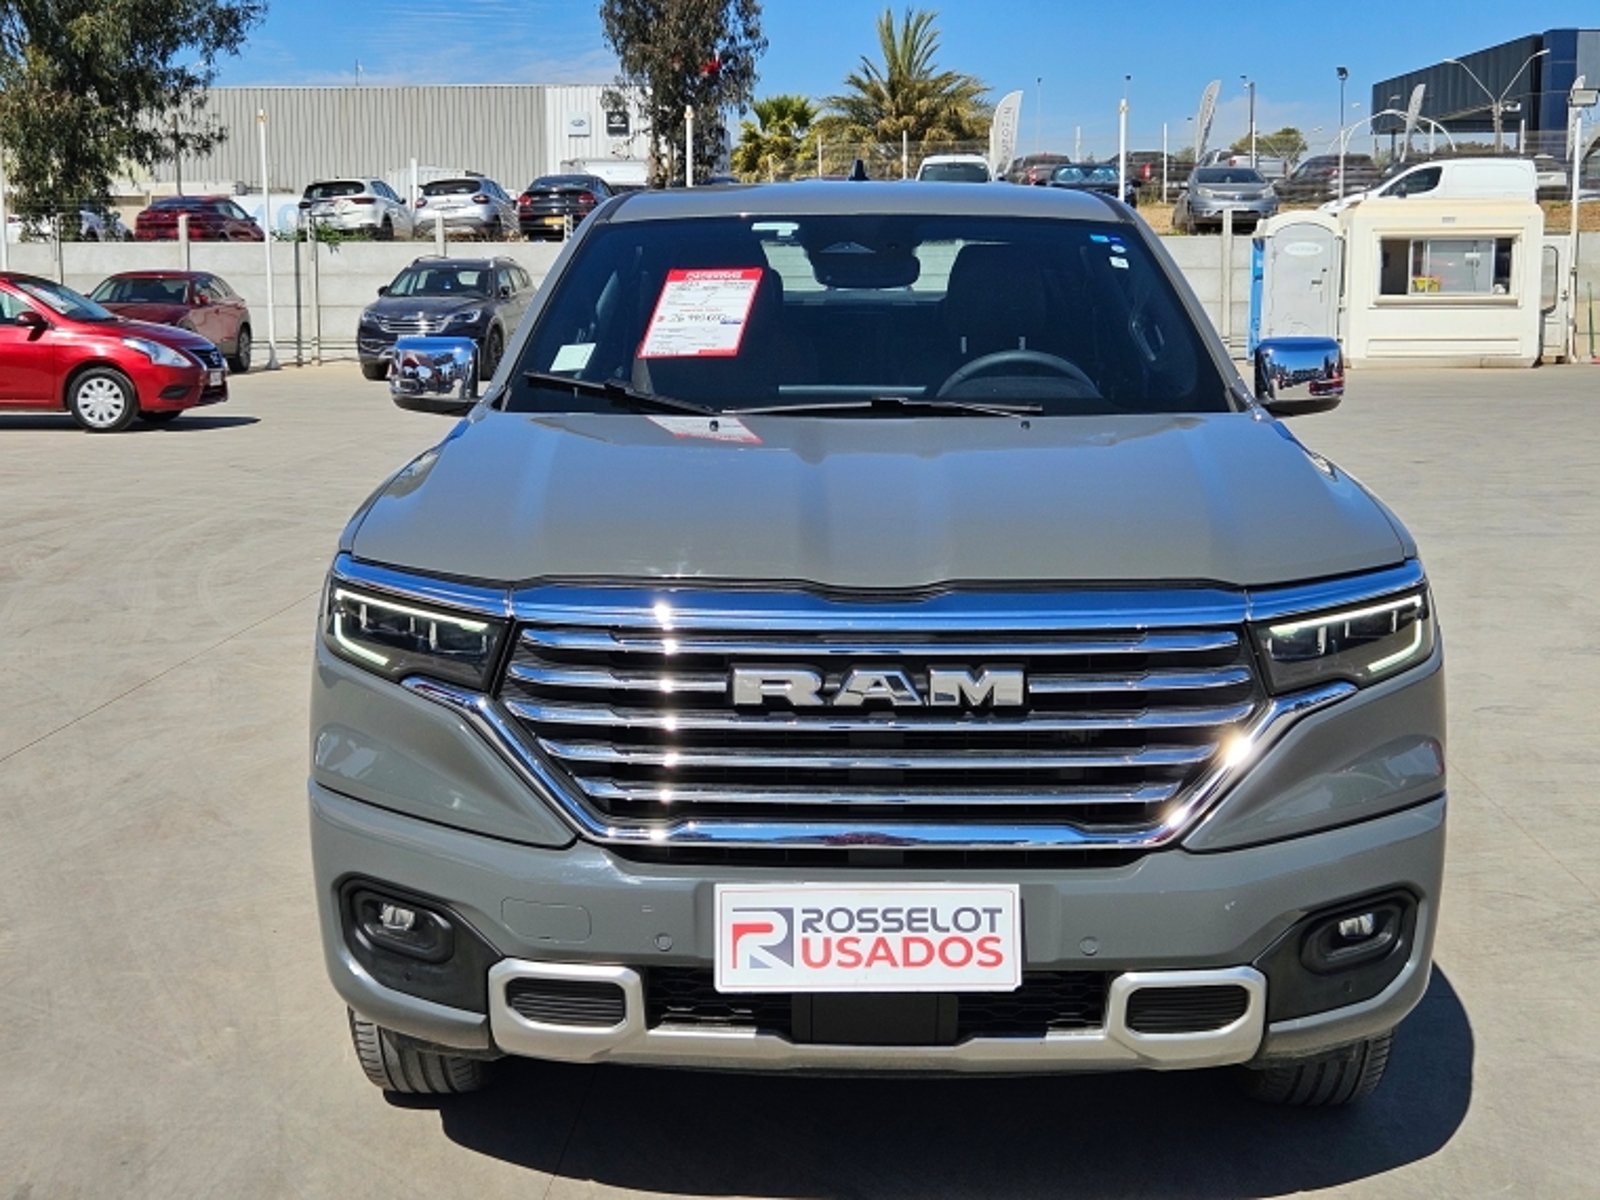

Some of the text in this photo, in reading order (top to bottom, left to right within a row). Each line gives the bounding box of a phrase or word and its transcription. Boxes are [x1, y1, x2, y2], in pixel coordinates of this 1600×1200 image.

[732, 663, 1025, 707] RAM
[801, 907, 1003, 933] ROSSELOT
[801, 936, 1004, 969] USADOS
